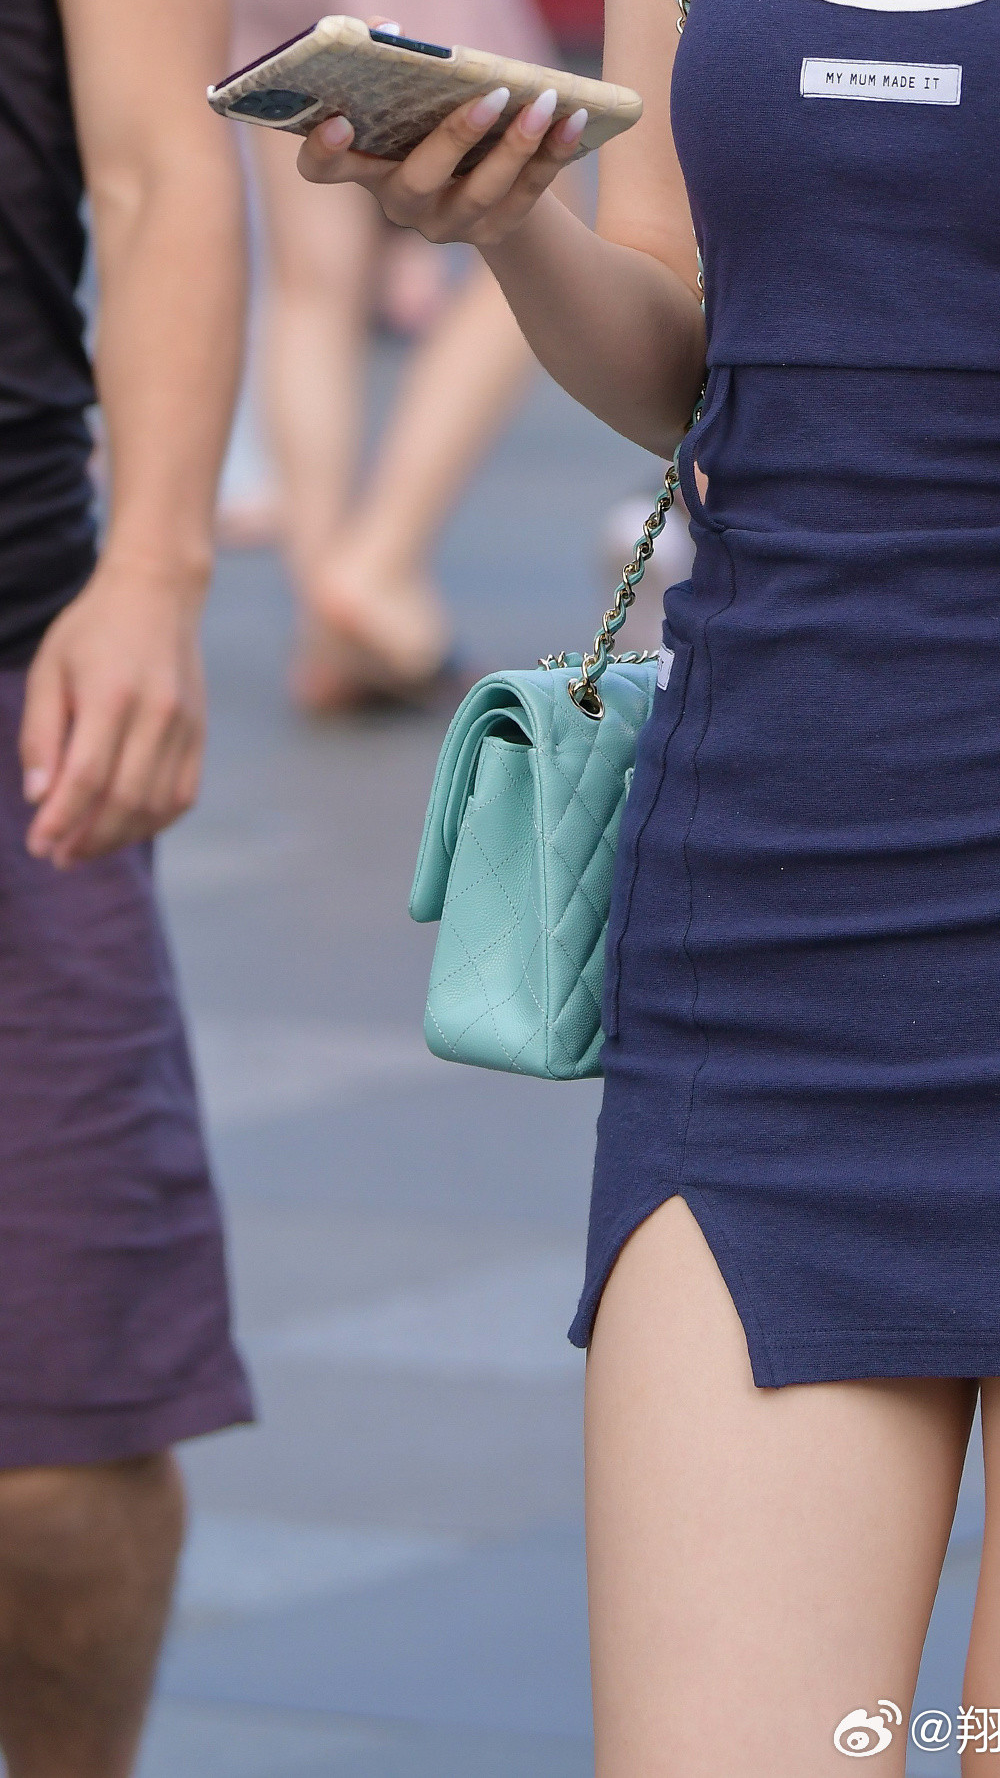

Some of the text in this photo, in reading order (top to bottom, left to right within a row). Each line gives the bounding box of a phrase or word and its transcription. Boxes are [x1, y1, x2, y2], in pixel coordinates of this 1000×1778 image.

[826, 72, 940, 89] MY MUM MADE IT
